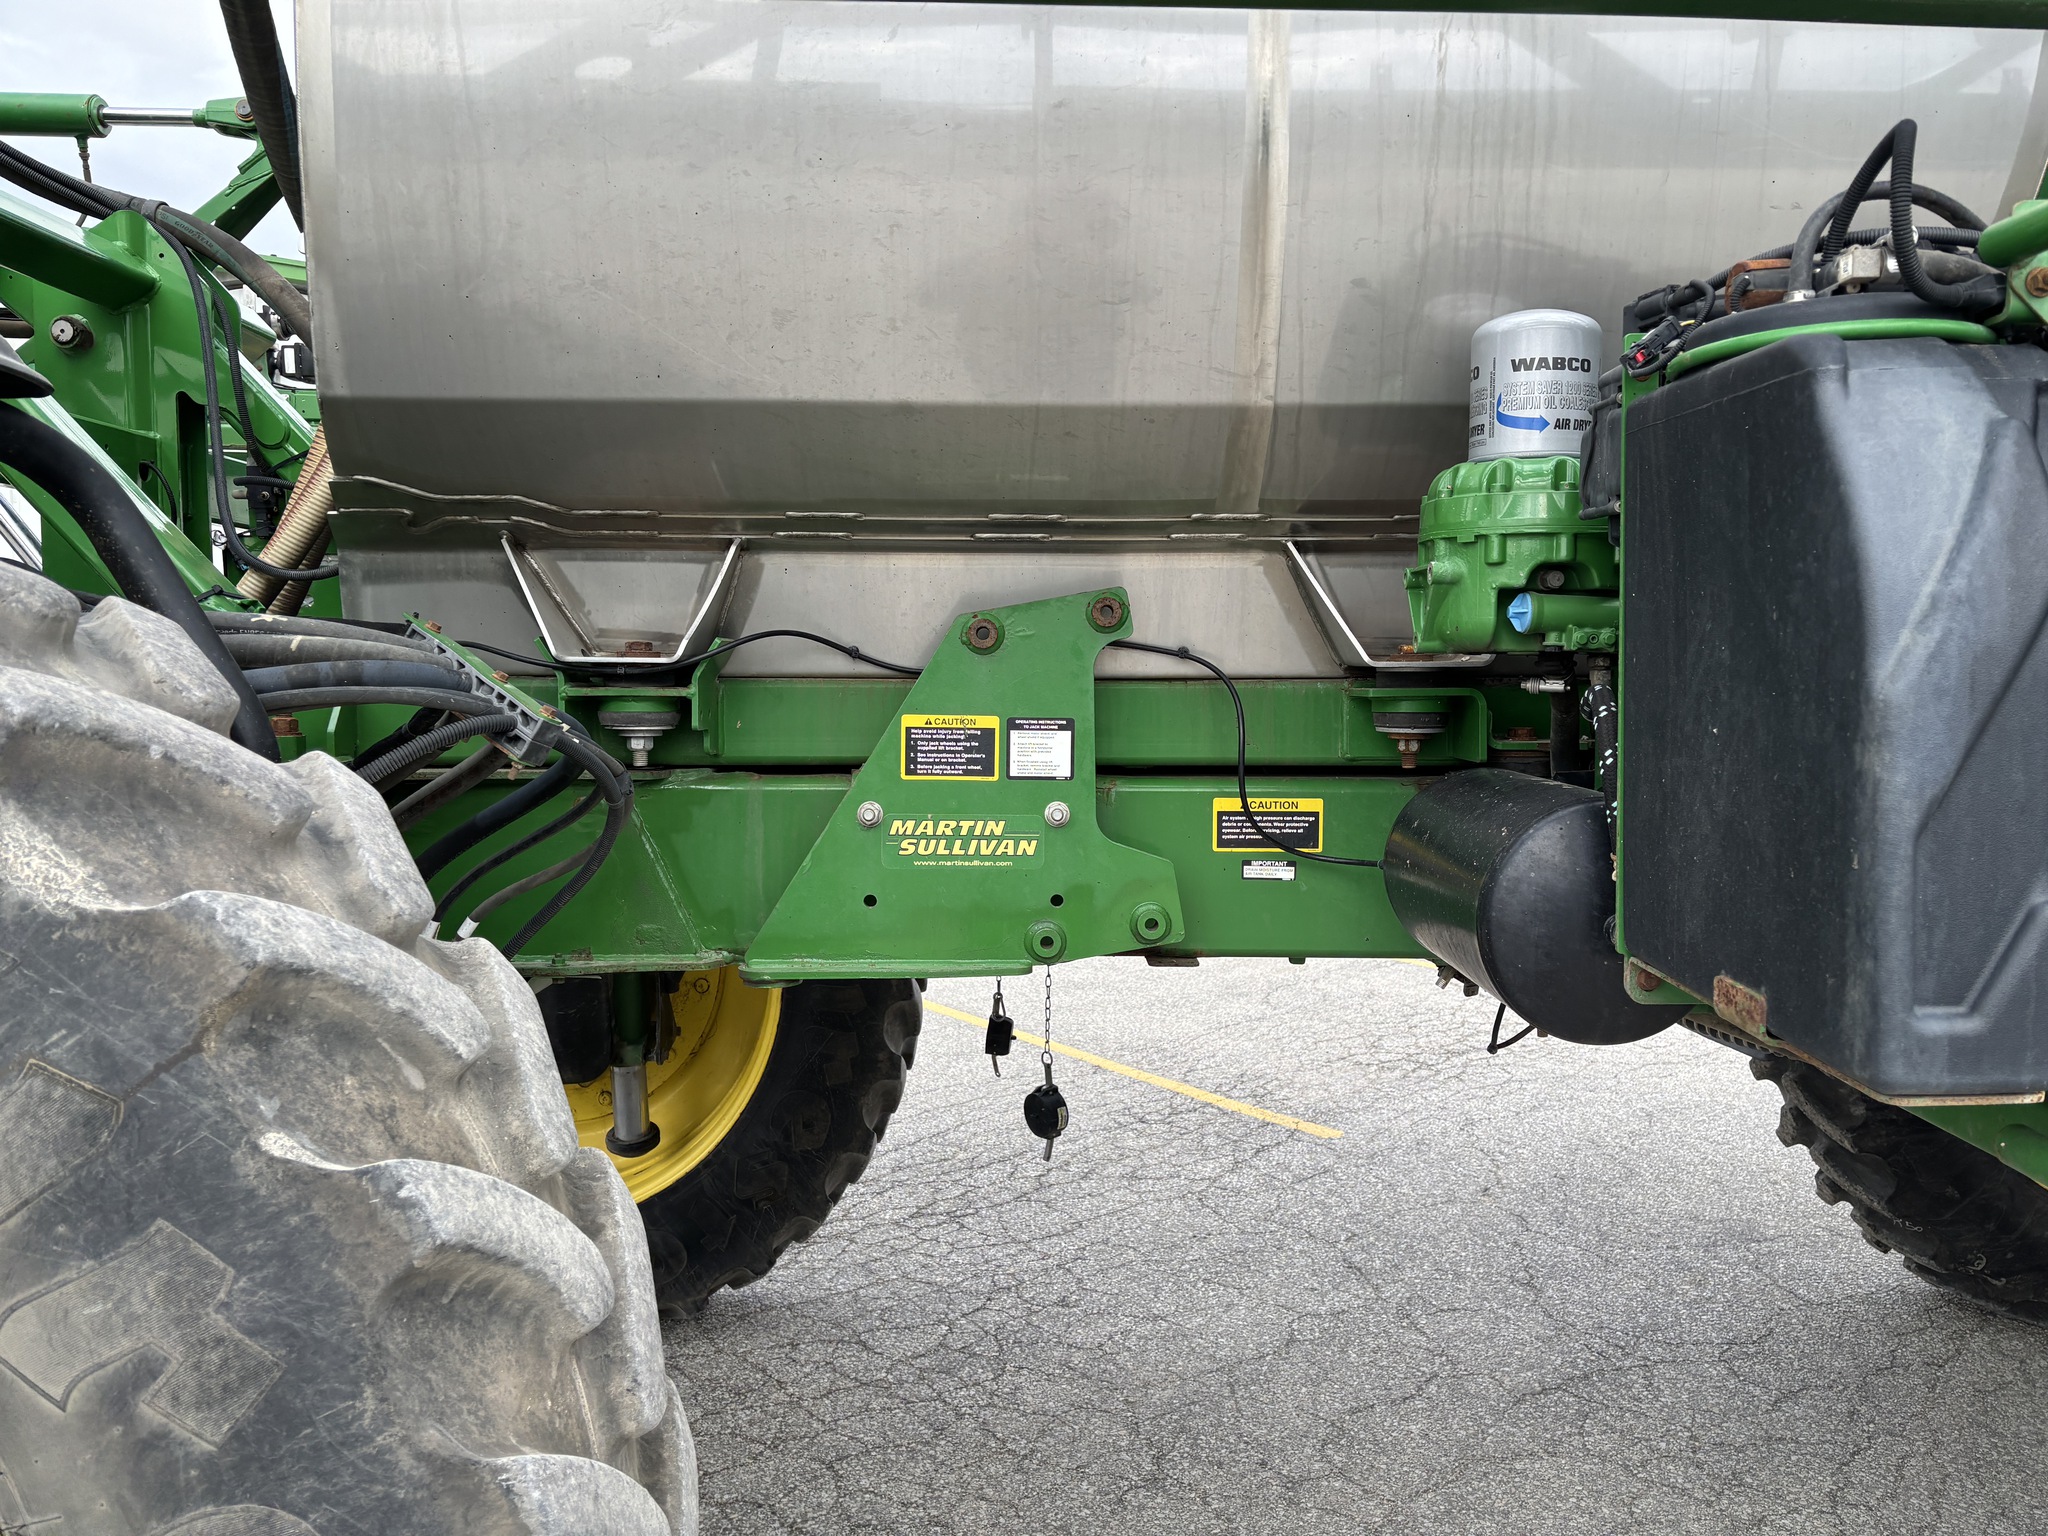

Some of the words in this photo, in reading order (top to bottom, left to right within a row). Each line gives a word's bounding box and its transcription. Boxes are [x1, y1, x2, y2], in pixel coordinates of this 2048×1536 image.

[1510, 356, 1591, 373] WABCO
[1503, 381, 1535, 397] SYSTEM
[1537, 380, 1563, 394] SAVER
[1565, 381, 1582, 395] 1200
[1502, 396, 1540, 412] PREMIUM
[1544, 396, 1557, 409] OIL
[1554, 418, 1572, 430] AIR
[1573, 418, 1592, 432] DRY
[934, 718, 976, 726] CAUTION
[1250, 800, 1298, 810] CAUTION
[888, 819, 1006, 836] MARTIN
[898, 838, 1038, 856] SULLIVAN
